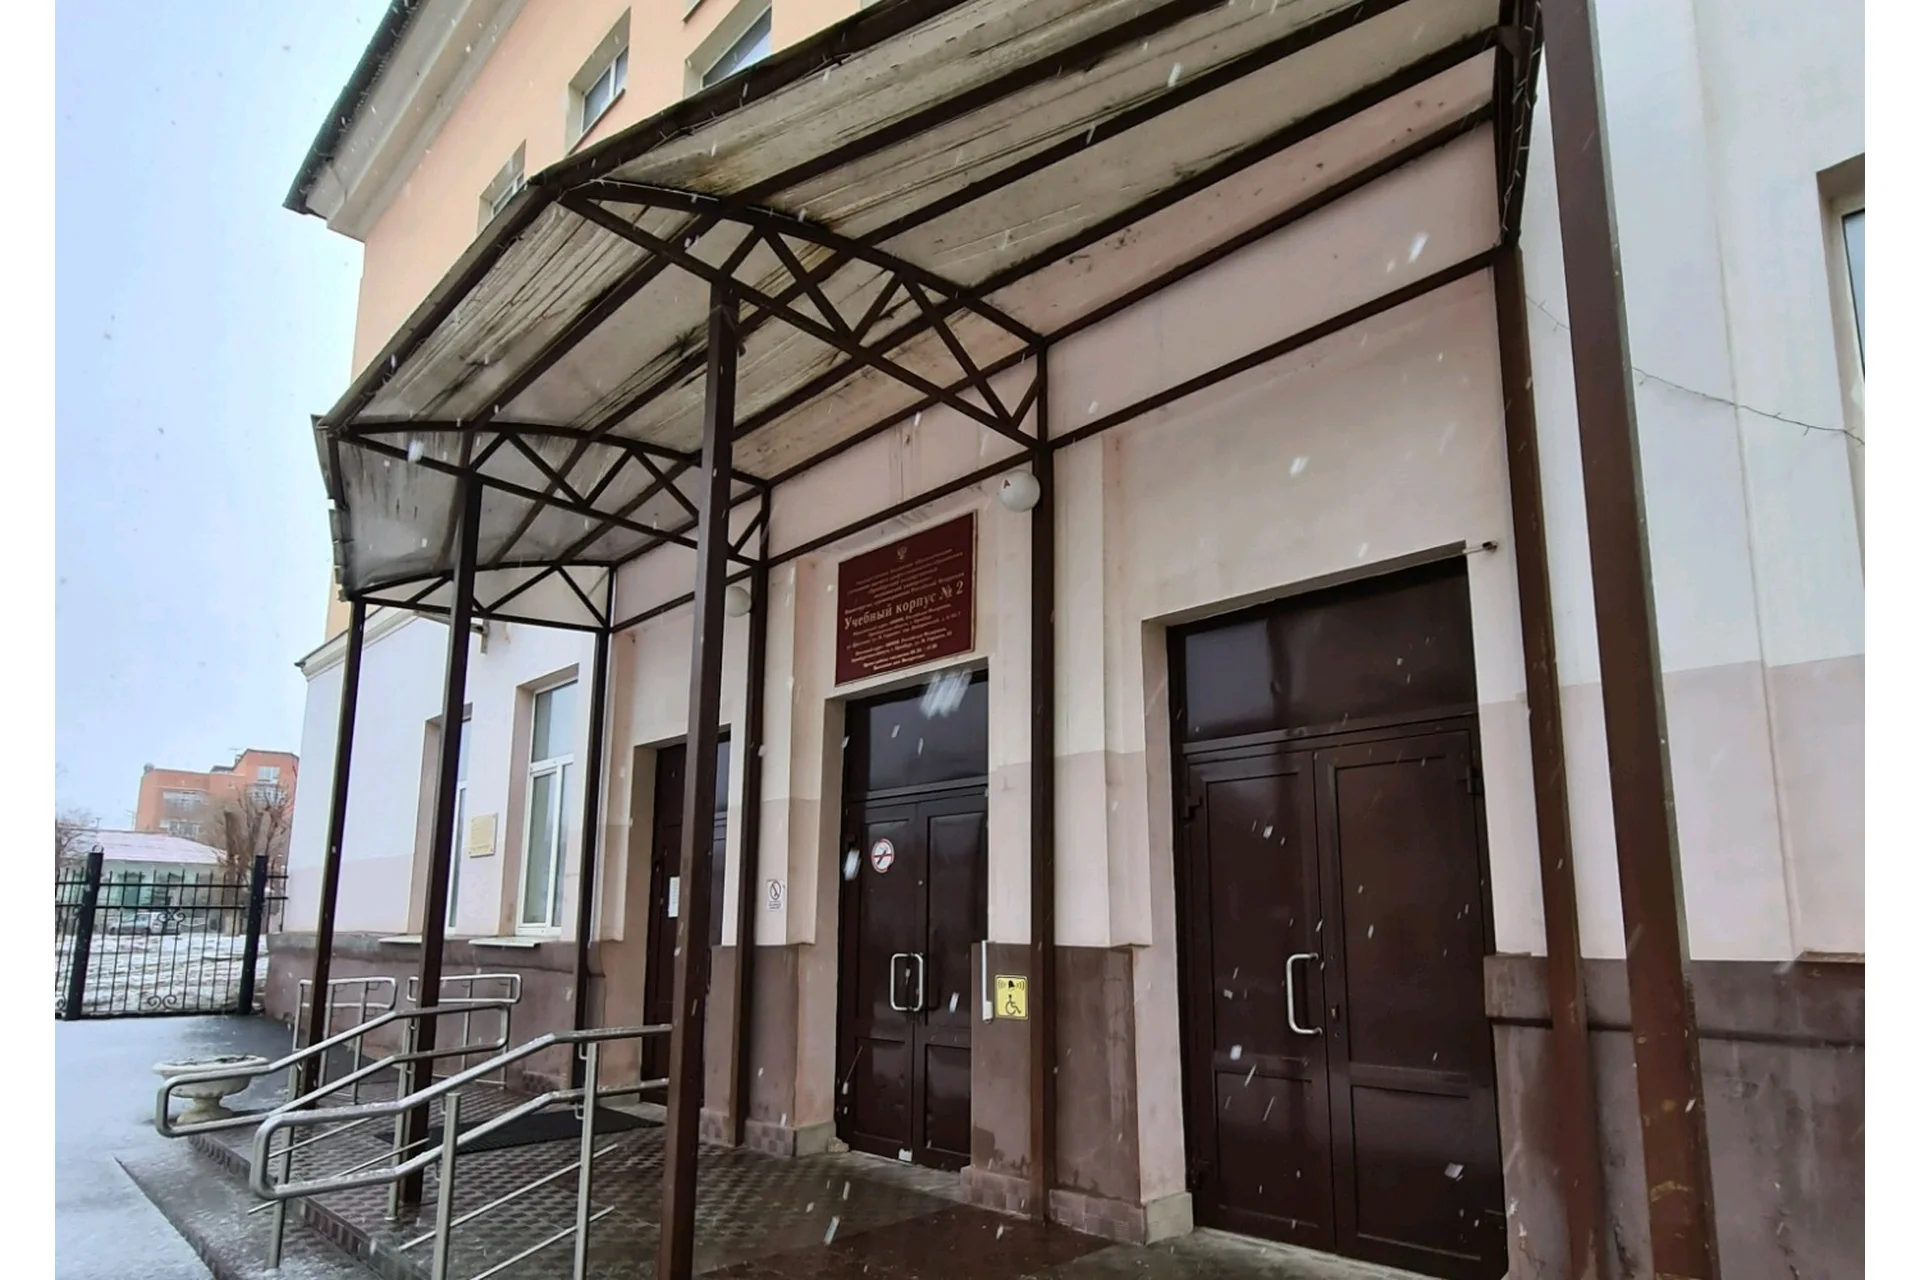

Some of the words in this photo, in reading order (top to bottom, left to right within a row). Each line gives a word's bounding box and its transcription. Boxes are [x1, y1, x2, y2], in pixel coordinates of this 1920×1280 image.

[844, 604, 892, 630] Учебный
[895, 593, 937, 614] корпус
[939, 584, 953, 600] №
[956, 580, 964, 595] 2
